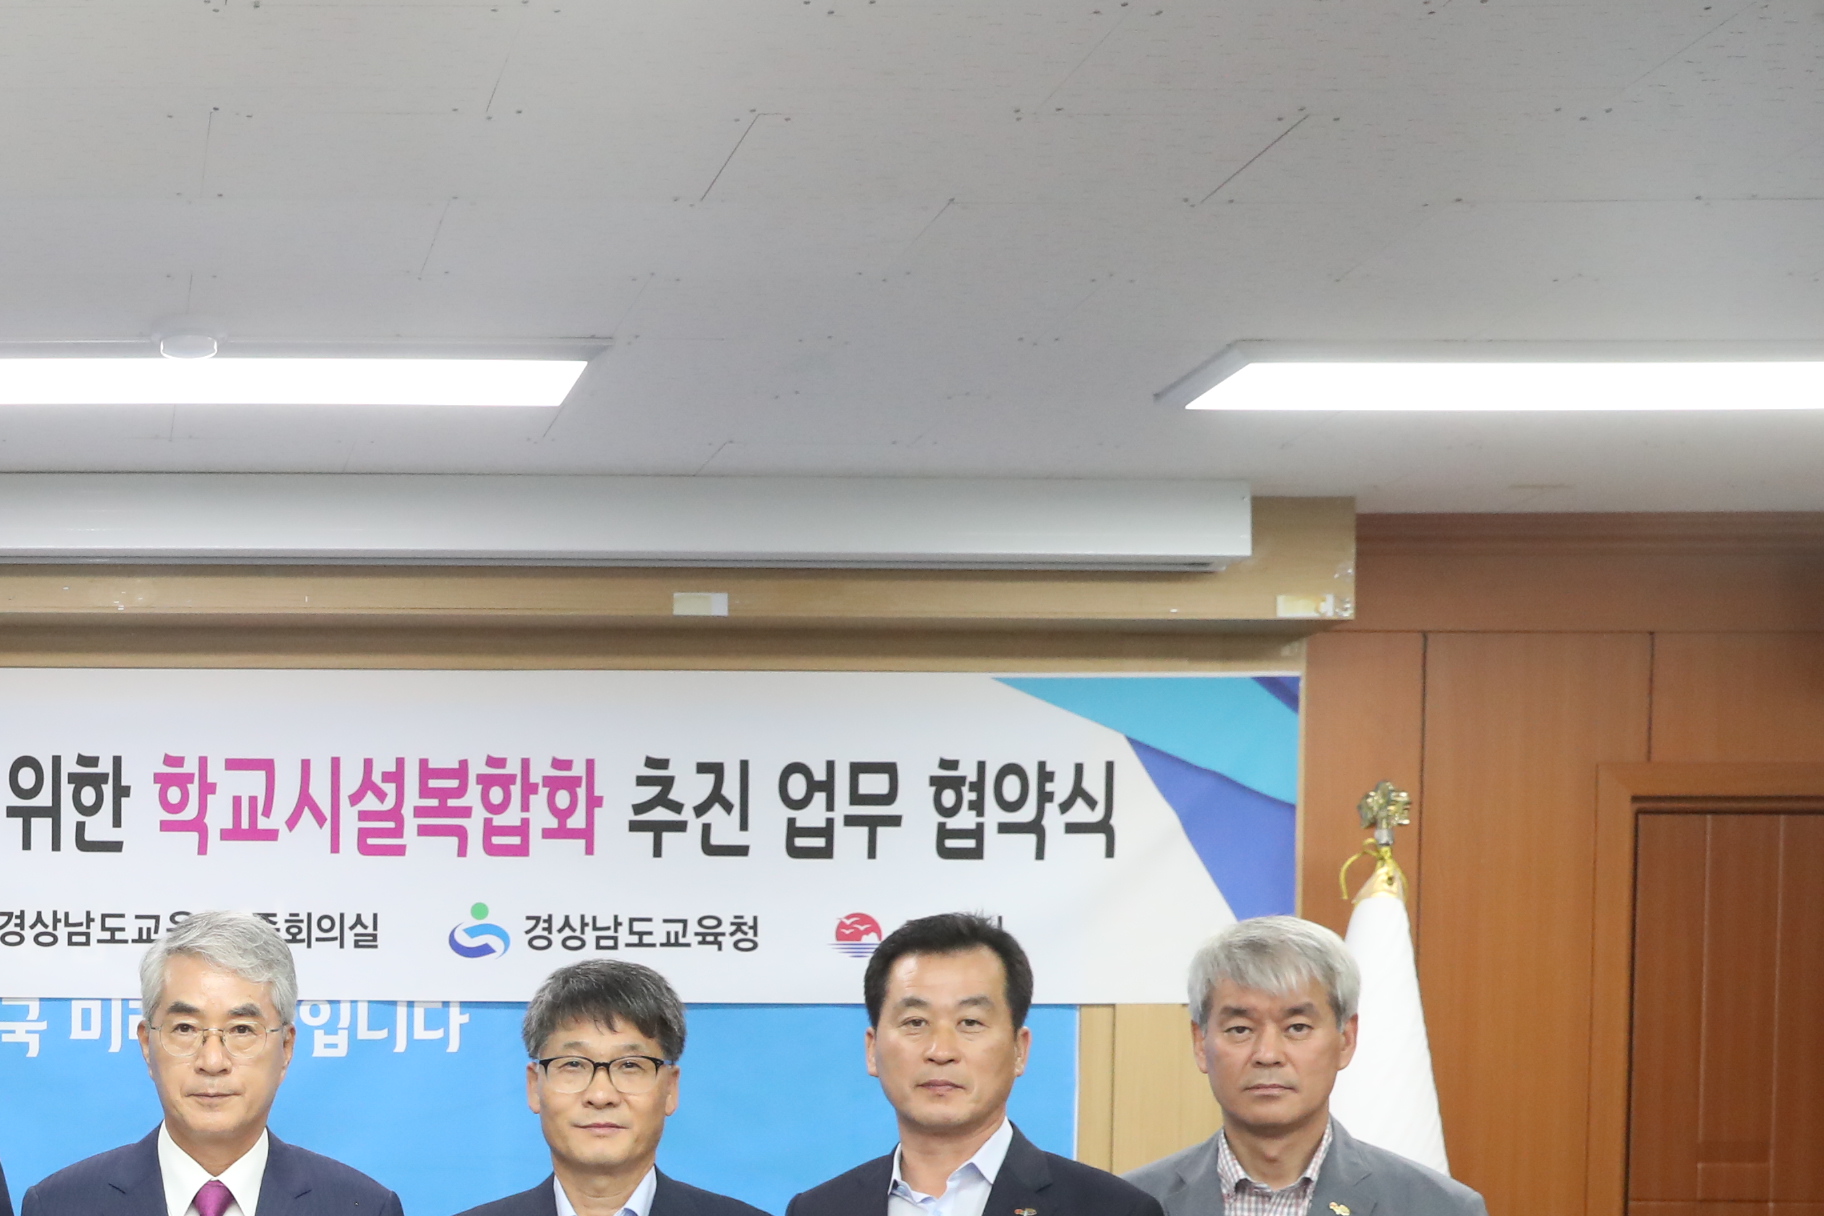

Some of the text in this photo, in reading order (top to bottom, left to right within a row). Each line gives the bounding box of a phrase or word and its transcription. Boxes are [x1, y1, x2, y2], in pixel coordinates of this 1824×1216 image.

[5, 752, 131, 854] 위한
[153, 752, 604, 858] 학교시설복합화
[628, 755, 751, 859] 추진
[777, 757, 904, 860] 업무
[927, 756, 1117, 861] 협약식
[522, 912, 760, 953] 경상남도교육청
